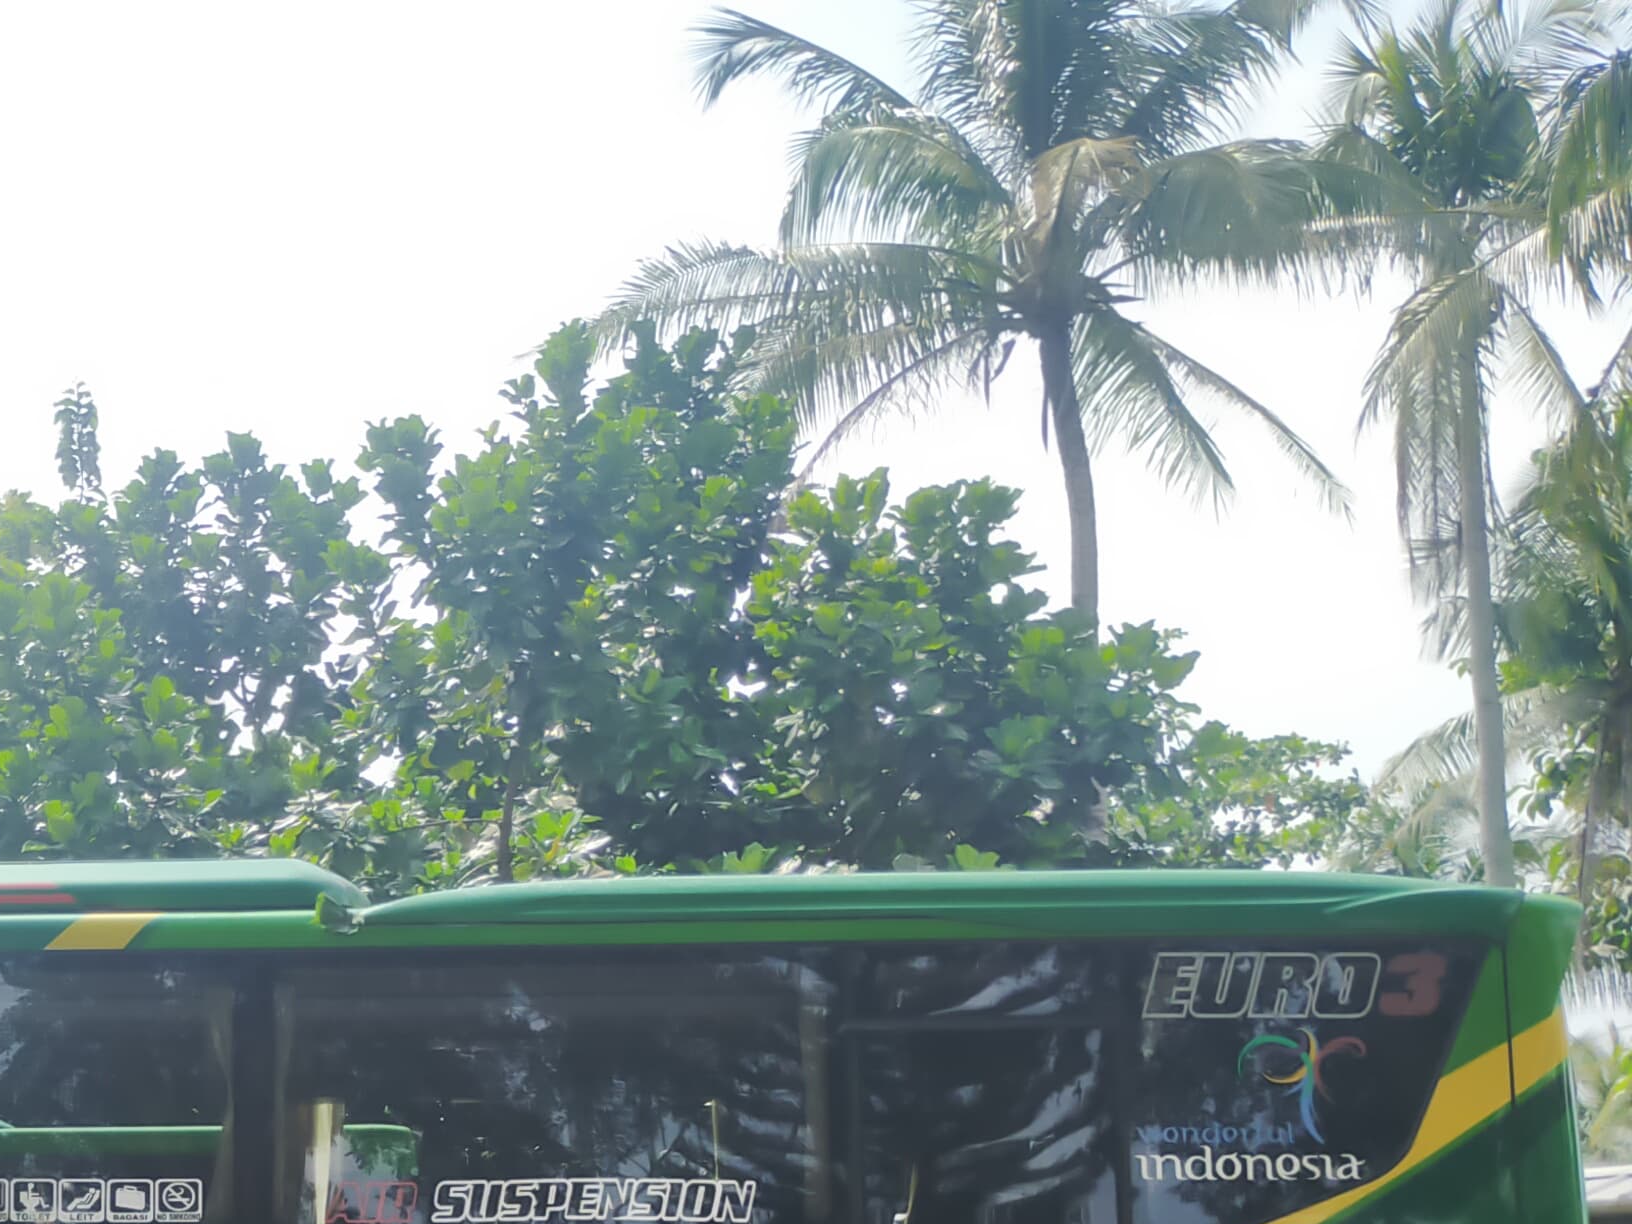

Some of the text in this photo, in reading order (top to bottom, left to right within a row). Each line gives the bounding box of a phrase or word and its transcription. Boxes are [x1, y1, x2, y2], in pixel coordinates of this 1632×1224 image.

[1142, 952, 1447, 1018] EURO 3
[1135, 1145, 1366, 1181] indonesia
[325, 1178, 757, 1224] AIR SUSPENSION
